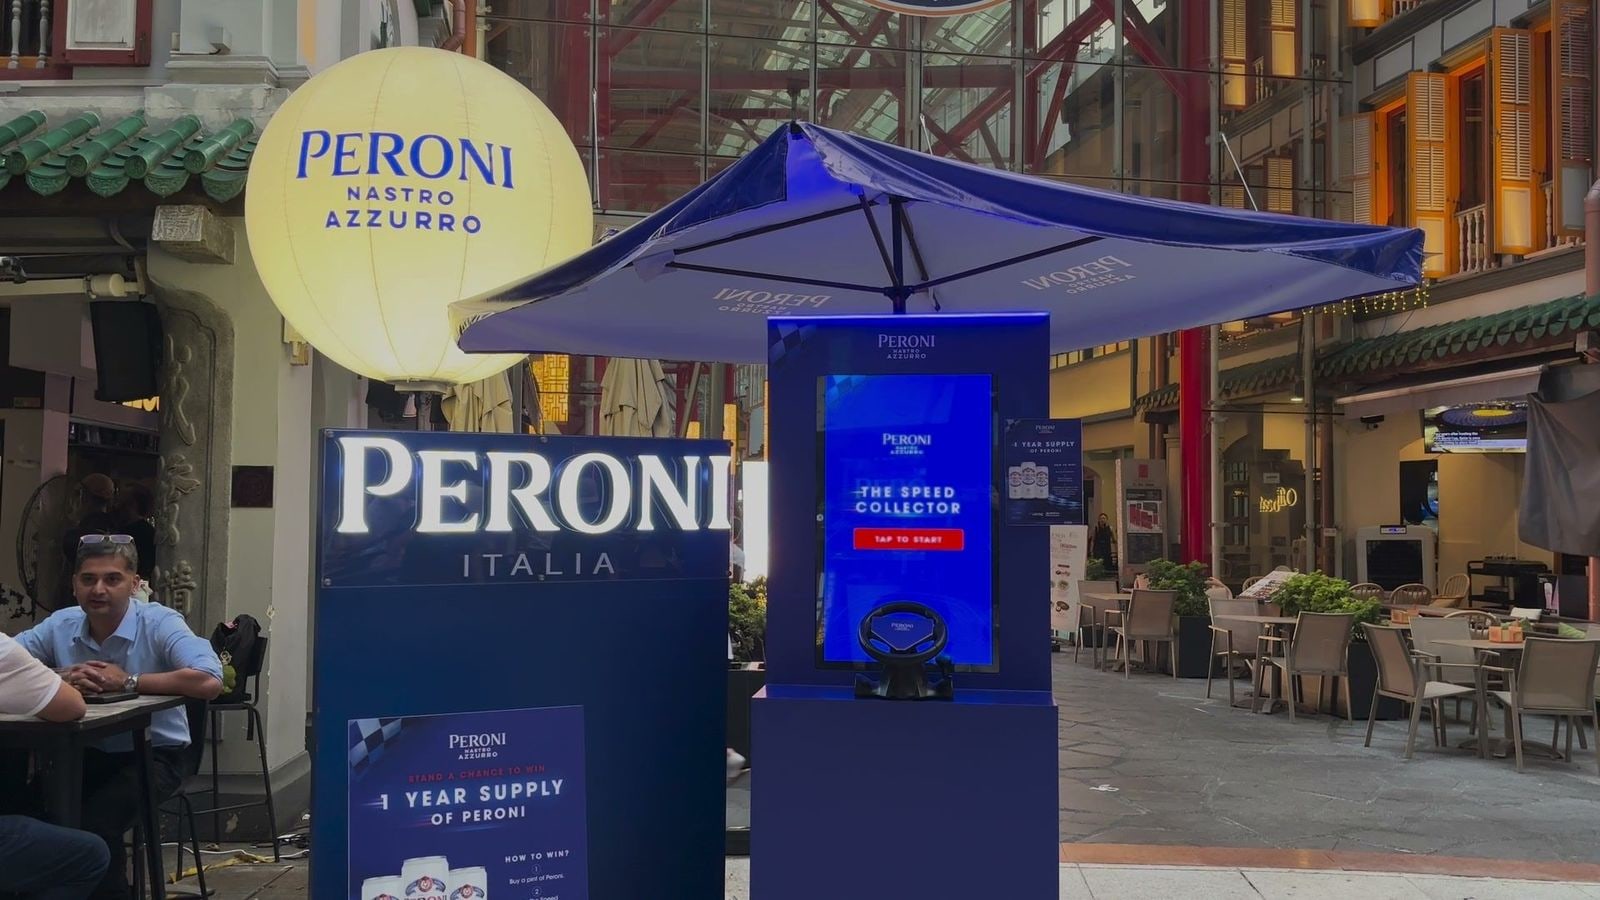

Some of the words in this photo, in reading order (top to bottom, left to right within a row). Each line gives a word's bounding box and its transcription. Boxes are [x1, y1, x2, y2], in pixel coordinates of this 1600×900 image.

[296, 130, 514, 189] PERONI
[347, 186, 454, 206] NASTRO
[325, 210, 481, 234] AZZURRO
[878, 334, 935, 348] PERONI
[882, 433, 932, 445] PERONI
[337, 436, 731, 535] PERONI
[861, 486, 892, 498] THE
[901, 486, 955, 498] SPEED
[855, 502, 960, 514] COLLECTOR
[463, 552, 615, 577] ITALIA
[449, 732, 506, 749] PERONI
[458, 751, 498, 760] AZZURRO
[408, 773, 442, 784] STAND
[448, 772, 455, 780] A
[460, 768, 503, 779] CHANCE
[509, 767, 521, 775] TO
[526, 764, 545, 773] WIN
[380, 794, 388, 810] 1
[406, 788, 467, 808] YEAR
[480, 779, 564, 802] SUPPLY
[431, 812, 453, 826] OF
[463, 806, 526, 823] PERONI
[505, 854, 526, 863] HOW
[530, 852, 542, 860] TO
[546, 849, 569, 858] WIN?
